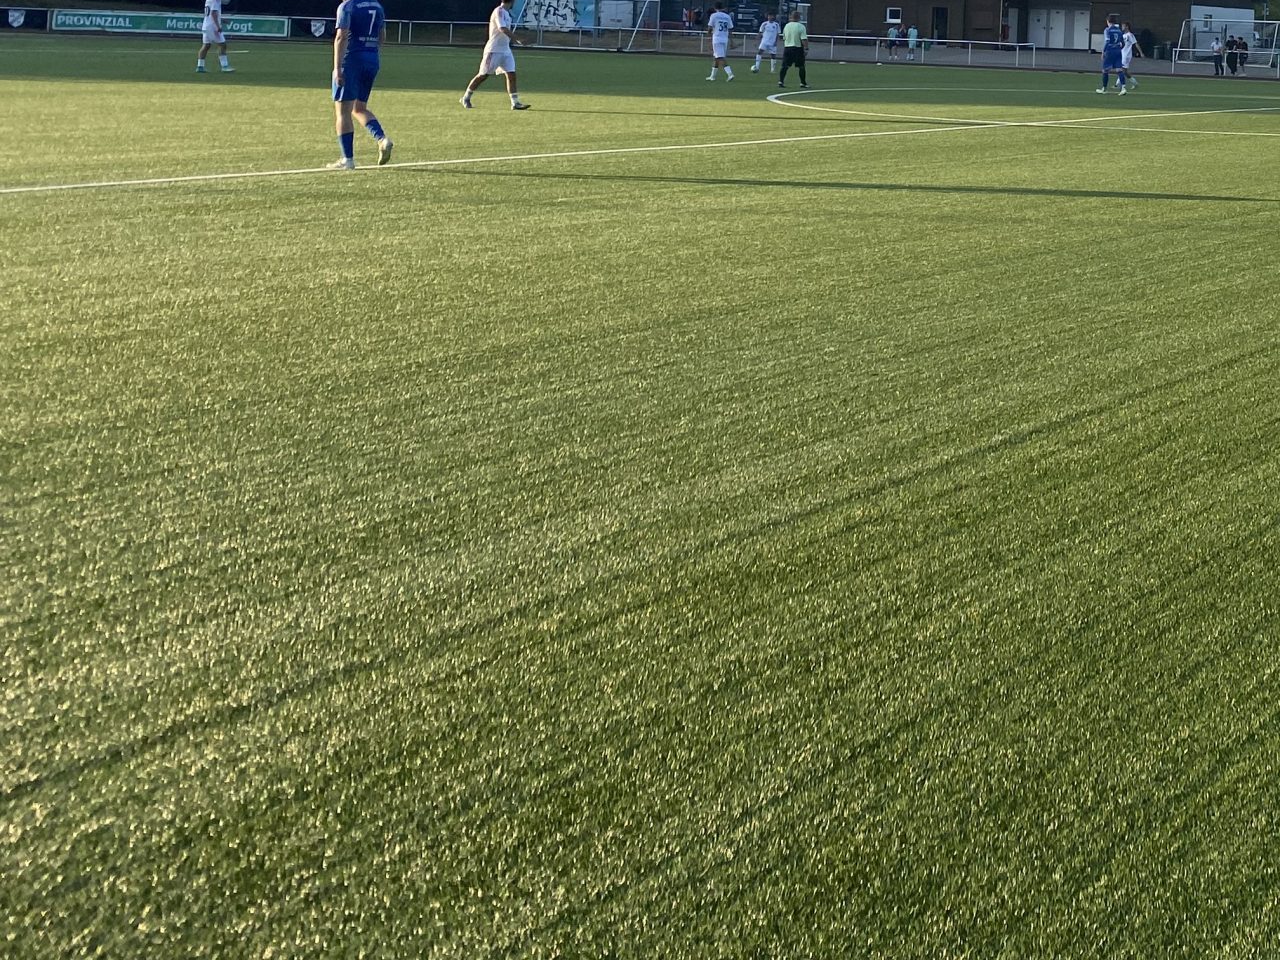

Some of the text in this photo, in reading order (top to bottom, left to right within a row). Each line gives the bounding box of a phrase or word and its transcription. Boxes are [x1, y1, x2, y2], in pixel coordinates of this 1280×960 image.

[57, 15, 133, 28] PROVINZIAL
[166, 19, 203, 30] Merke
[368, 9, 377, 36] 7
